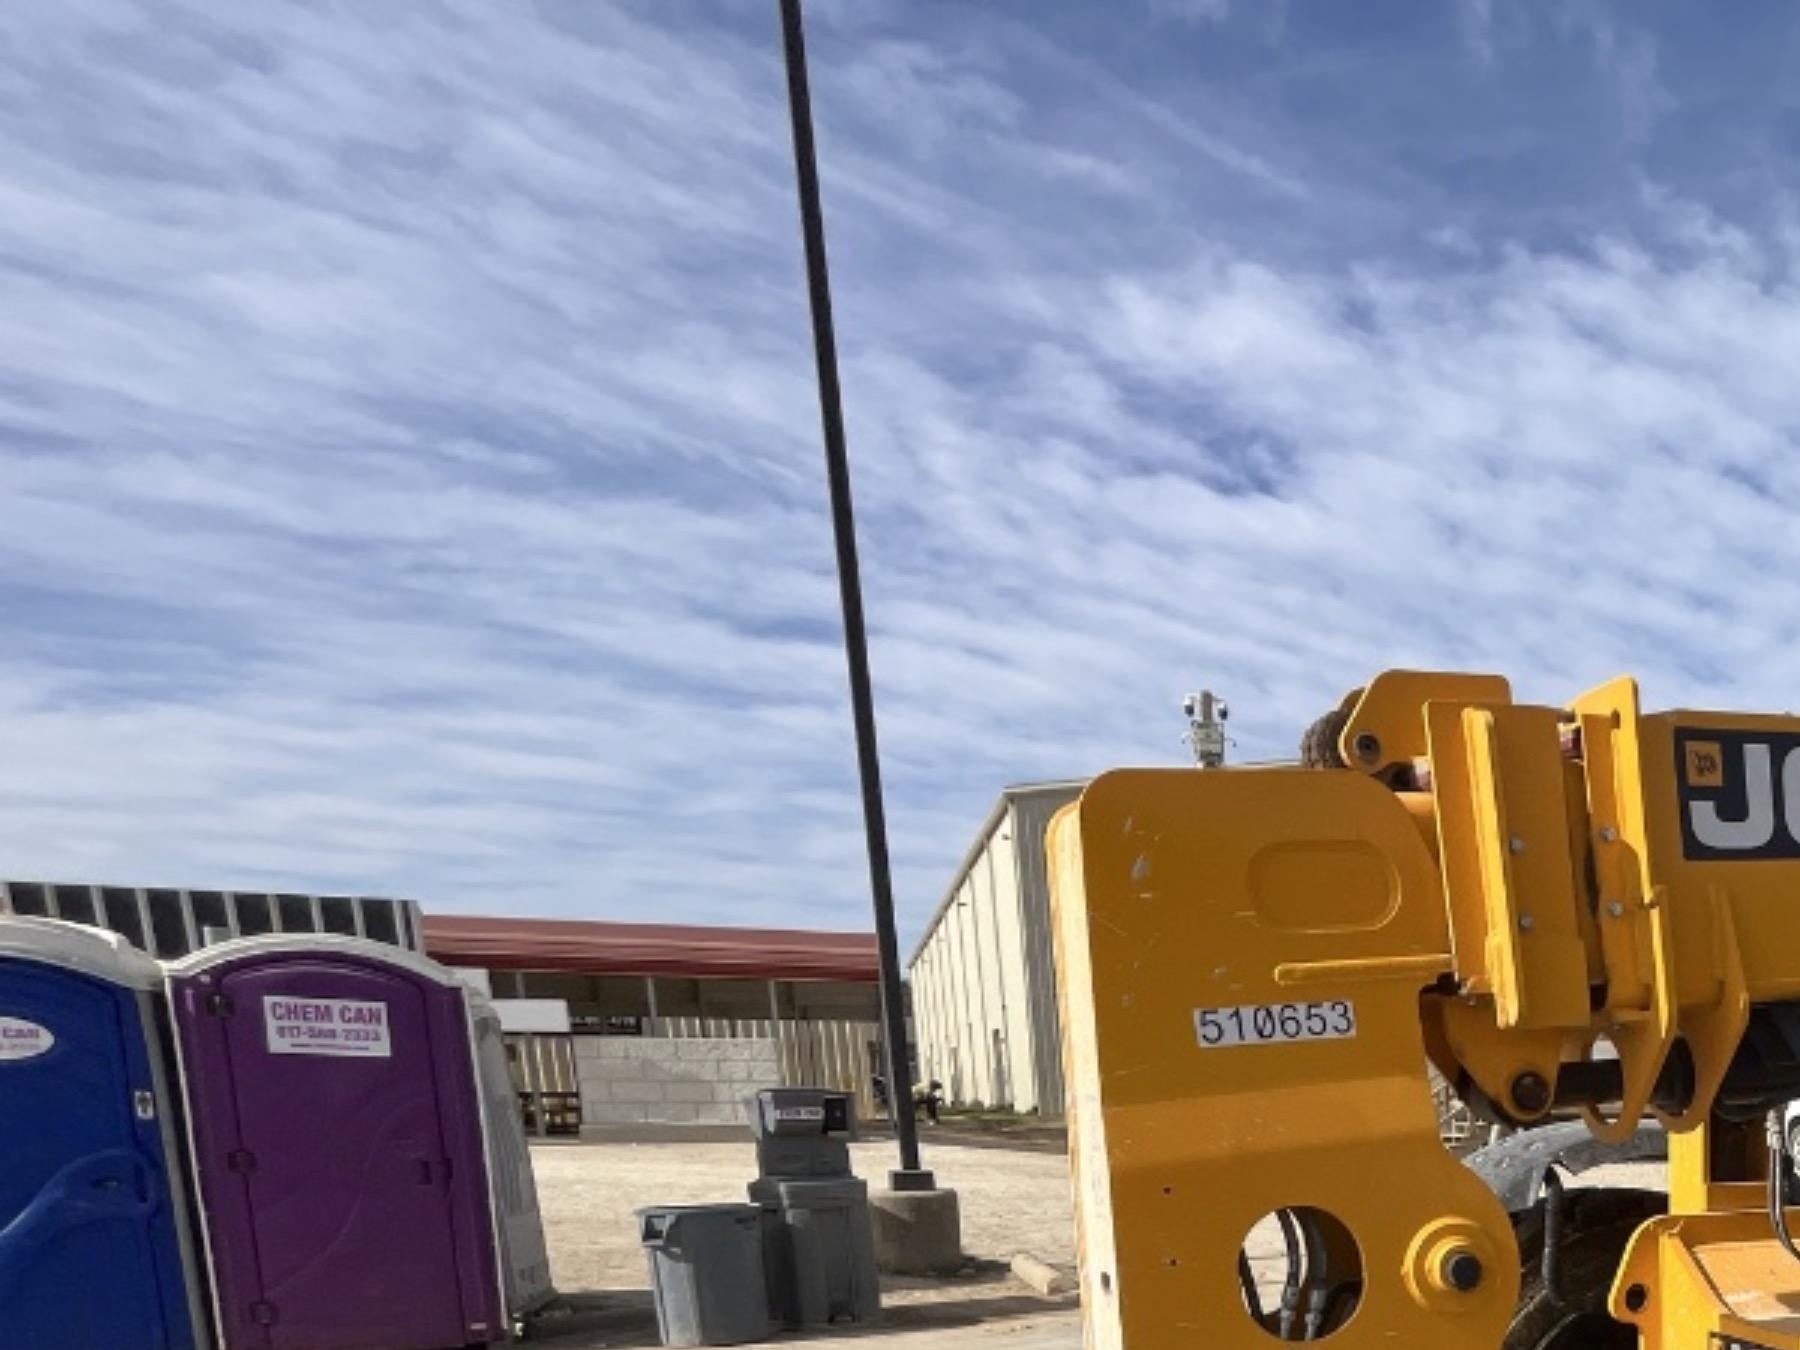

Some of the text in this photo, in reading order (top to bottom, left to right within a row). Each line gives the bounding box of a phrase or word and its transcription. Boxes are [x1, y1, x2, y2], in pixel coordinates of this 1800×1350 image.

[271, 1001, 382, 1026] CHEM CAN
[1201, 1001, 1353, 1044] 510653
